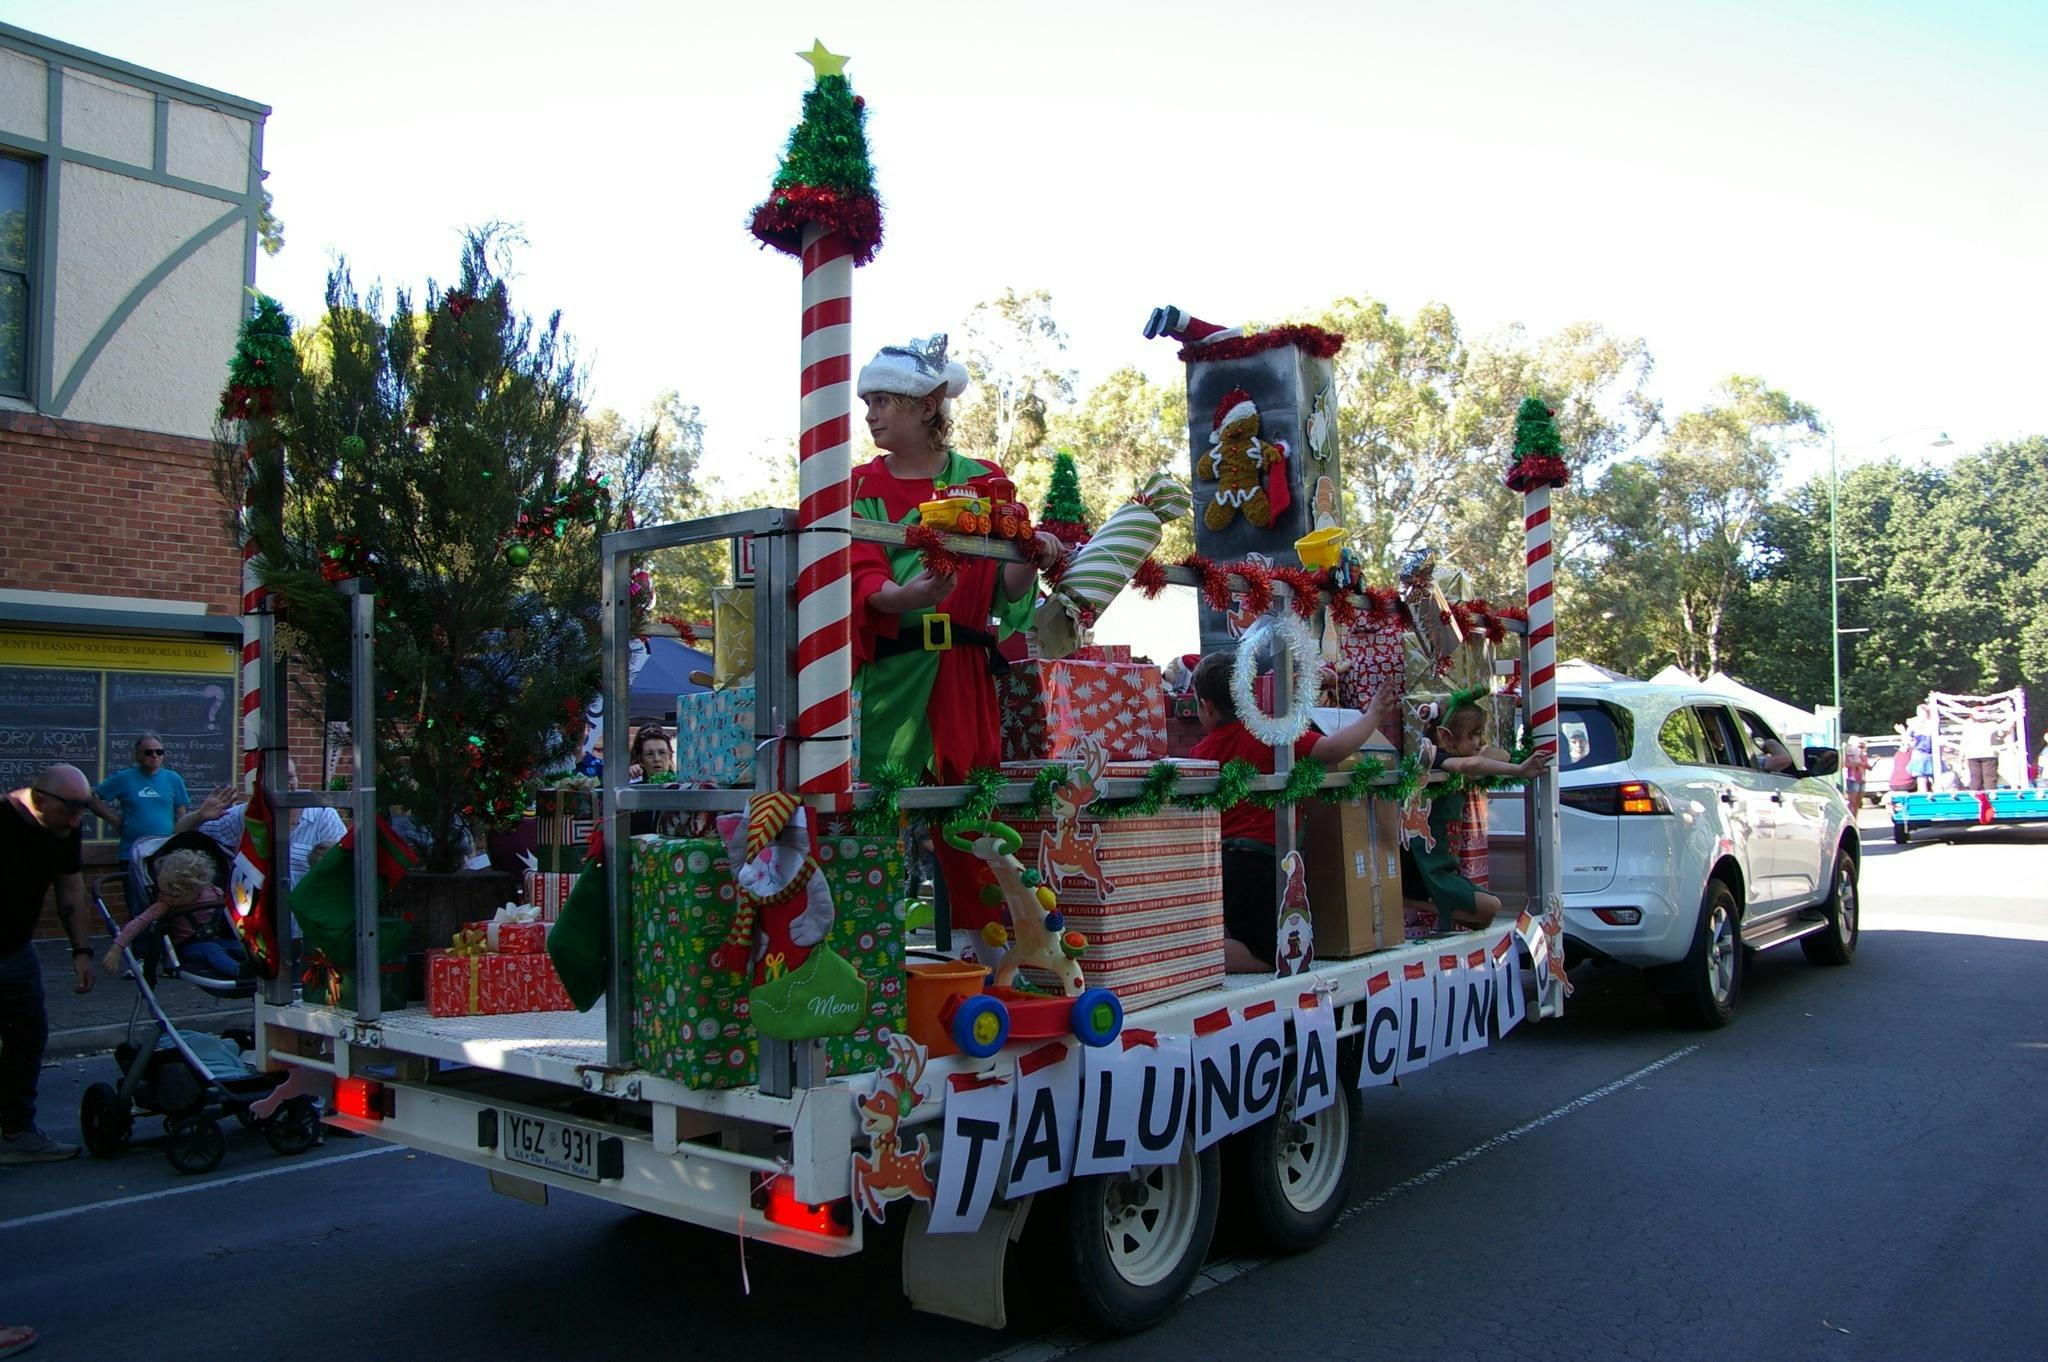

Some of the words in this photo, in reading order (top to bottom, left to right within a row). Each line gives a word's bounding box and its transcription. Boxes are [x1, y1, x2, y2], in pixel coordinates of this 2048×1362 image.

[31, 641, 81, 652] PLEASANT
[83, 644, 129, 655] SOLDIERS
[132, 646, 182, 657] MEMORIAL
[184, 648, 208, 658] HALL
[43, 732, 88, 745] ROOM
[807, 995, 860, 1018] Meow
[955, 1030, 1329, 1217] TALUNGA
[509, 1114, 545, 1154] YGZ
[562, 1128, 591, 1166] 931
[544, 1156, 571, 1171] Festival
[571, 1163, 590, 1175] State
